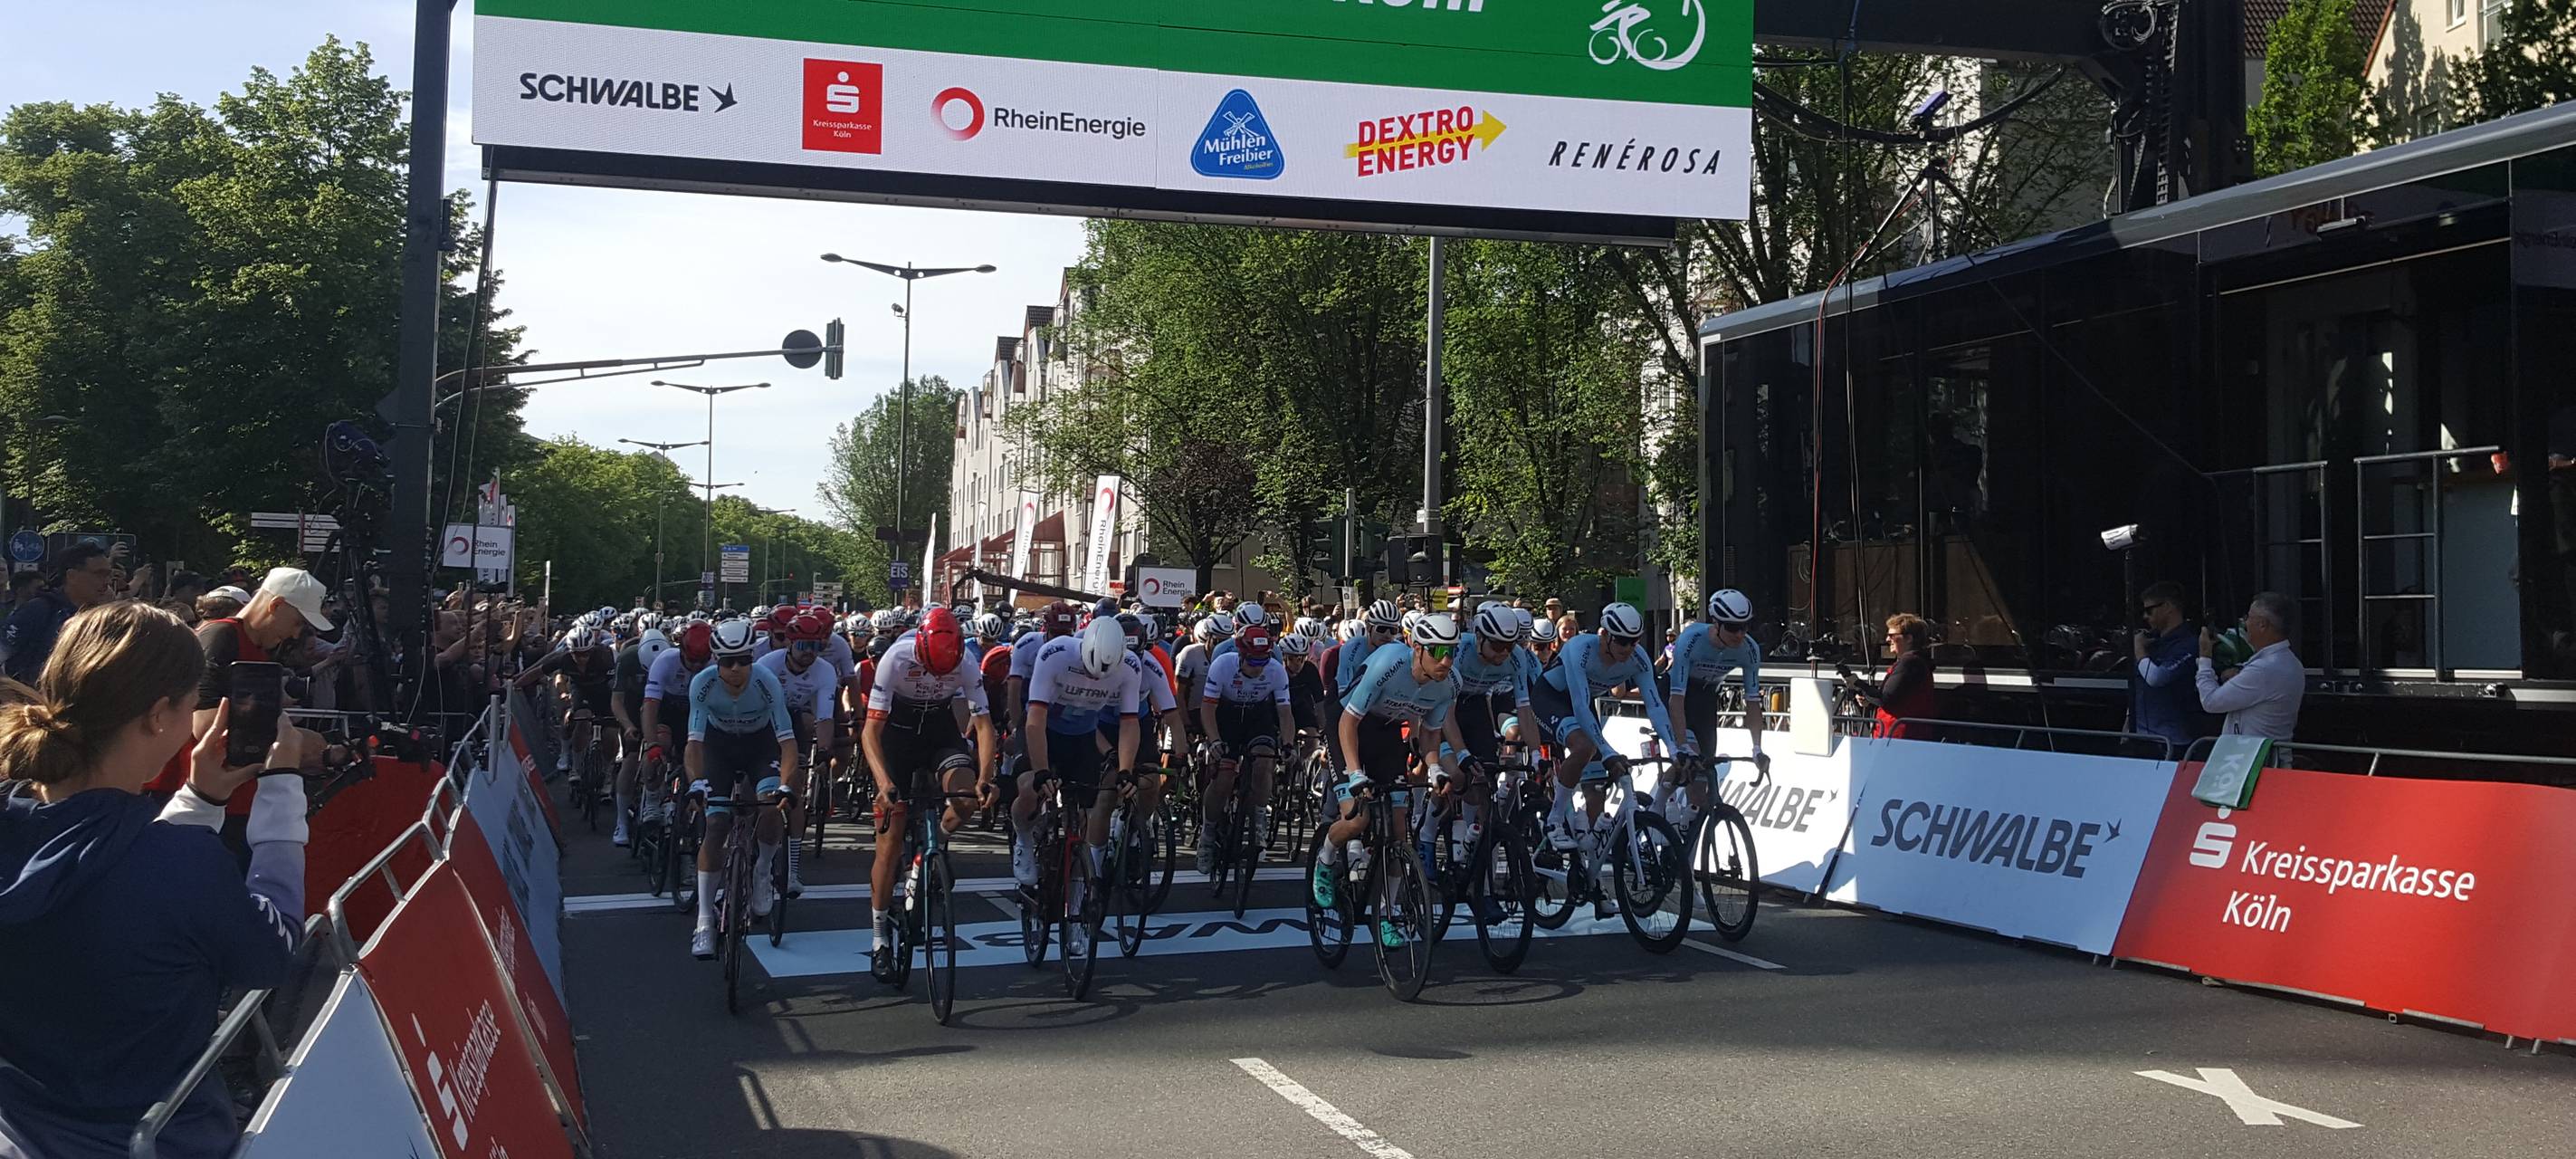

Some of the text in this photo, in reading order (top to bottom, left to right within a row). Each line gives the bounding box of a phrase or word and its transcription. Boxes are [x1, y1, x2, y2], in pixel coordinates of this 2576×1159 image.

[520, 72, 700, 112] SCHWALBE
[813, 119, 873, 130] Kreissparkasse
[833, 129, 852, 139] Köln
[994, 107, 1147, 139] RheinEnergie
[1358, 106, 1474, 144] DEXTRO
[1204, 133, 1266, 154] Mühlen
[1219, 148, 1274, 166] Freibier
[1358, 135, 1475, 177] ENERGY
[1549, 139, 1721, 176] RENÉROSA
[890, 565, 909, 579] EIS
[1162, 580, 1185, 589] Rhein
[1375, 656, 1406, 688] GARMIN
[1870, 798, 2102, 879] SCHWALBE
[2240, 839, 2476, 902] Kreissparkasse
[2221, 890, 2293, 934] Köln
